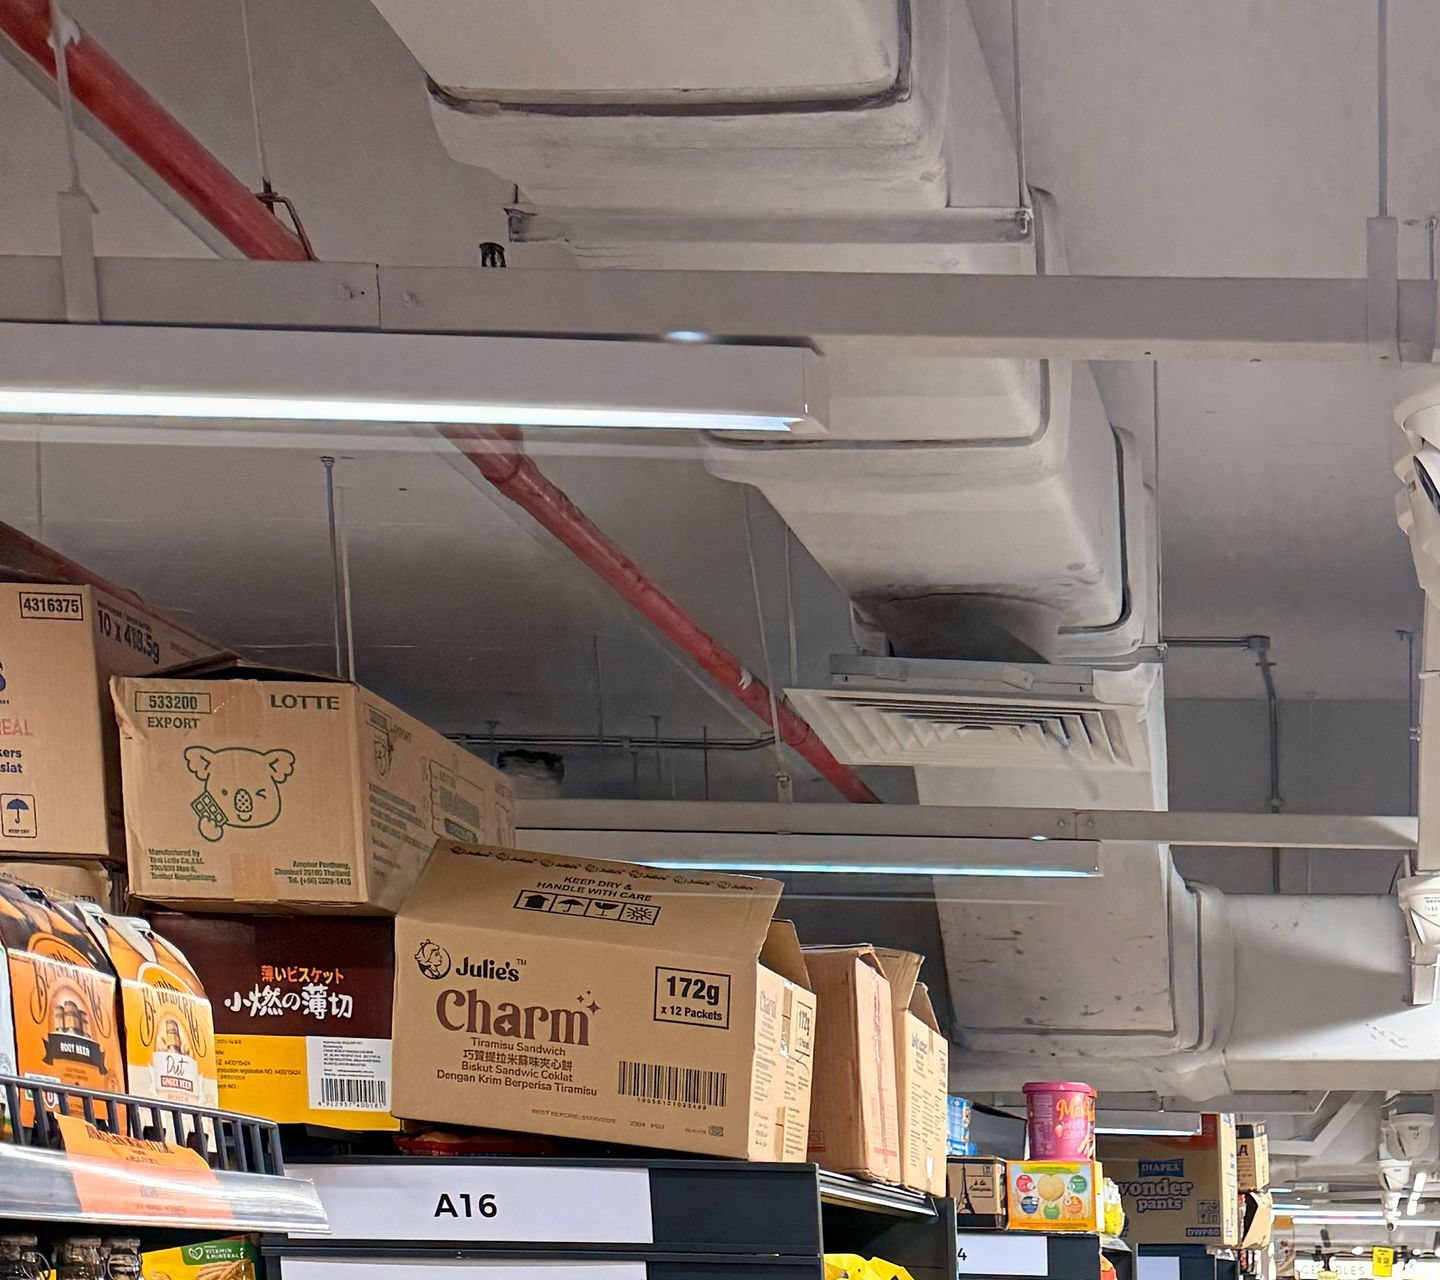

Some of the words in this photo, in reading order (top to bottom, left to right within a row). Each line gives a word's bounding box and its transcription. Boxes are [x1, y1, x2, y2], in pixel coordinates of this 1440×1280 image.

[23, 597, 80, 614] 4316375
[148, 694, 199, 711] 533200
[269, 694, 341, 711] LOTTE
[147, 716, 200, 730] EXPORT
[537, 881, 584, 894] HANDLE
[587, 887, 618, 898] WITH
[619, 891, 652, 902] CARE
[564, 875, 595, 886] KEEP
[598, 880, 622, 890] DRY
[455, 956, 521, 983] Julie's
[666, 975, 721, 1006] 172g
[435, 987, 591, 1047] Charm
[660, 1006, 668, 1016] x
[669, 1006, 683, 1017] 12
[684, 1007, 724, 1022] Packets
[470, 1036, 515, 1051] Tiramisu
[516, 1042, 567, 1057] Sandwich
[165, 1054, 187, 1077] Diet
[461, 1060, 494, 1076] Biskut
[495, 1065, 539, 1080] Sandwic
[540, 1070, 574, 1083] Coklat
[436, 1069, 477, 1084] Dengan
[478, 1074, 503, 1087] Krim
[504, 1077, 553, 1093] Berperisa
[554, 1082, 598, 1097] Tiramisu
[434, 1194, 498, 1218] A16
[1136, 1197, 1183, 1213] pants
